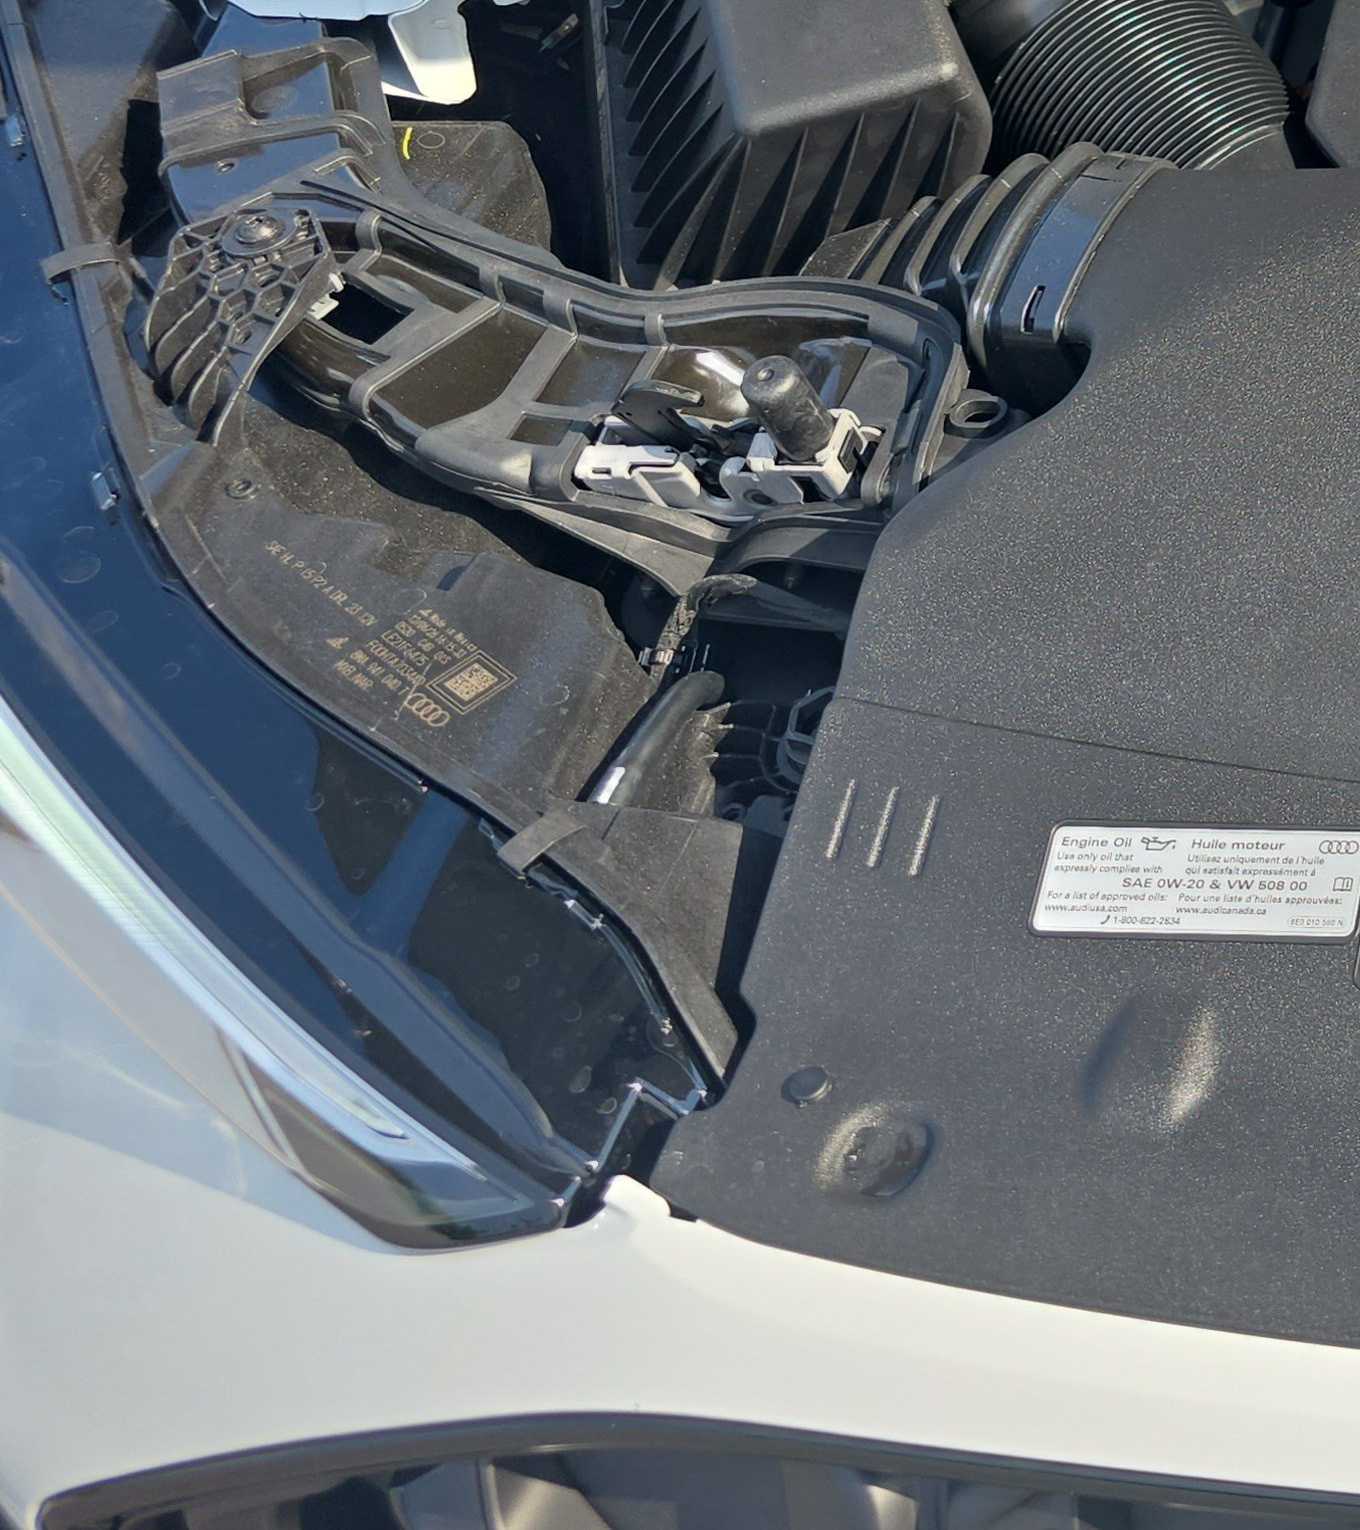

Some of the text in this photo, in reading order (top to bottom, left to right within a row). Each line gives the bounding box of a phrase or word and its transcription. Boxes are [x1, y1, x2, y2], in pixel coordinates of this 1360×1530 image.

[1061, 836, 1133, 848] Engine Oil
[1191, 839, 1285, 850] Huile moteur
[1057, 852, 1134, 862] Use only oil that
[1187, 854, 1221, 864] Utilisez
[1223, 855, 1280, 865] uniquement
[1282, 856, 1294, 865] de
[1054, 864, 1162, 874] expressly complies with
[1185, 866, 1201, 876] qui
[1202, 867, 1240, 876] satisfait
[1121, 877, 1308, 891] SAE 0W-20 & VW 508 00
[1047, 891, 1063, 900] For
[1072, 891, 1088, 900] list
[1090, 891, 1100, 900] of
[1101, 892, 1145, 902] approved
[1148, 893, 1168, 901] oils:
[1178, 893, 1200, 902] Pour
[1203, 895, 1221, 903] une
[1223, 894, 1243, 903] liste
[1045, 905, 1127, 913] www.audiusa.com
[1176, 907, 1267, 916] www.audicanada.ca
